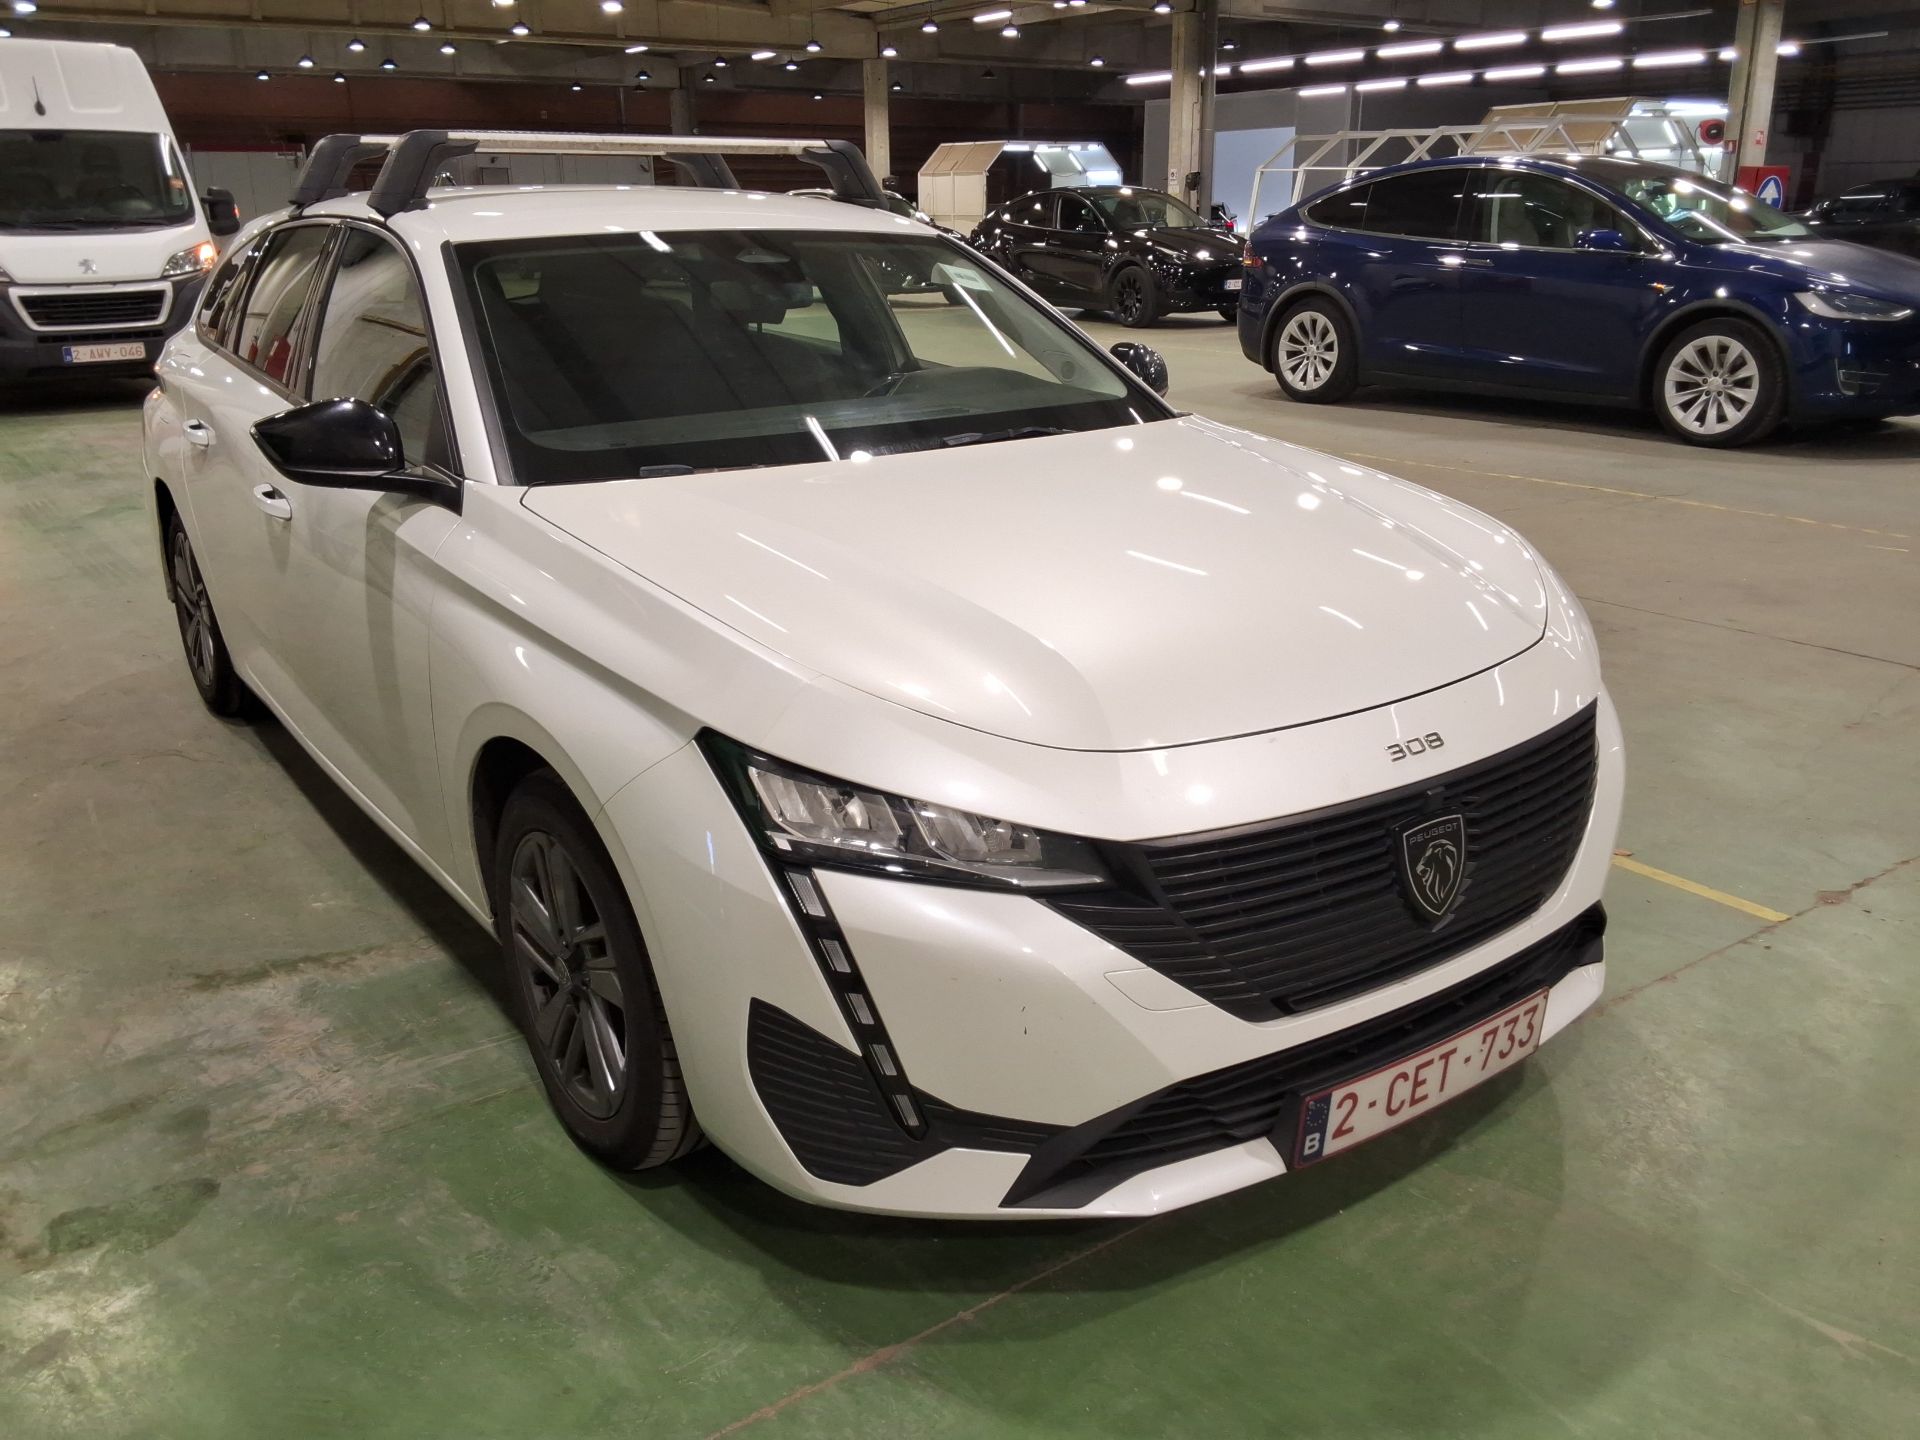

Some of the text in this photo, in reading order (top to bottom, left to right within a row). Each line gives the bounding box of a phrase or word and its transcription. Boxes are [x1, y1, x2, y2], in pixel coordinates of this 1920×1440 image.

[1384, 731, 1445, 762] 308
[1409, 822, 1458, 847] PEUGEOT
[1331, 1003, 1540, 1140] 2-CET-733
[1303, 1132, 1321, 1156] B
